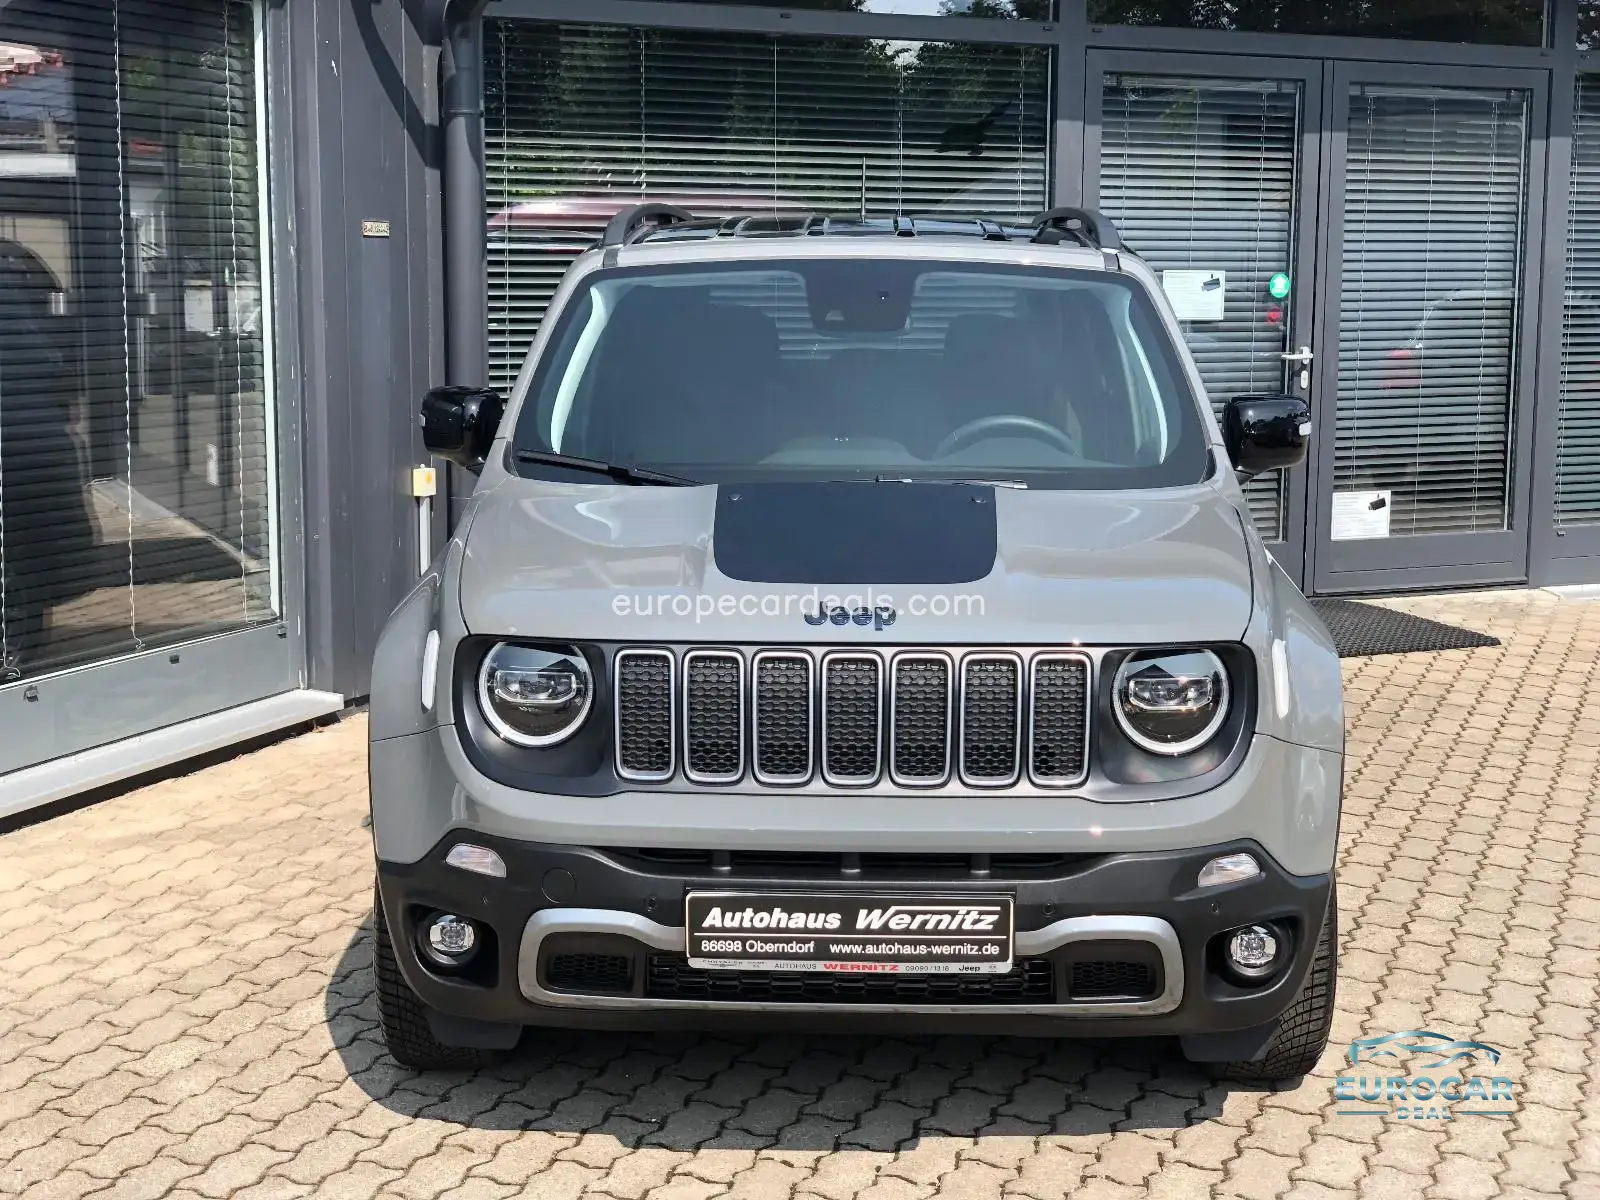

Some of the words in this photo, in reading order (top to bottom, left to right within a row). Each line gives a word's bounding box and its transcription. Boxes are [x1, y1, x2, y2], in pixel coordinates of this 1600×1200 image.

[804, 600, 897, 632] Jeep
[701, 907, 842, 929] Autohaus
[855, 905, 1001, 930] Wernitz
[701, 940, 742, 952] 86698
[746, 940, 815, 953] Oberndorf
[829, 942, 1000, 955] www.autohaus-wernitz.de
[823, 963, 899, 972] WERNITZ
[958, 964, 981, 973] Jeep
